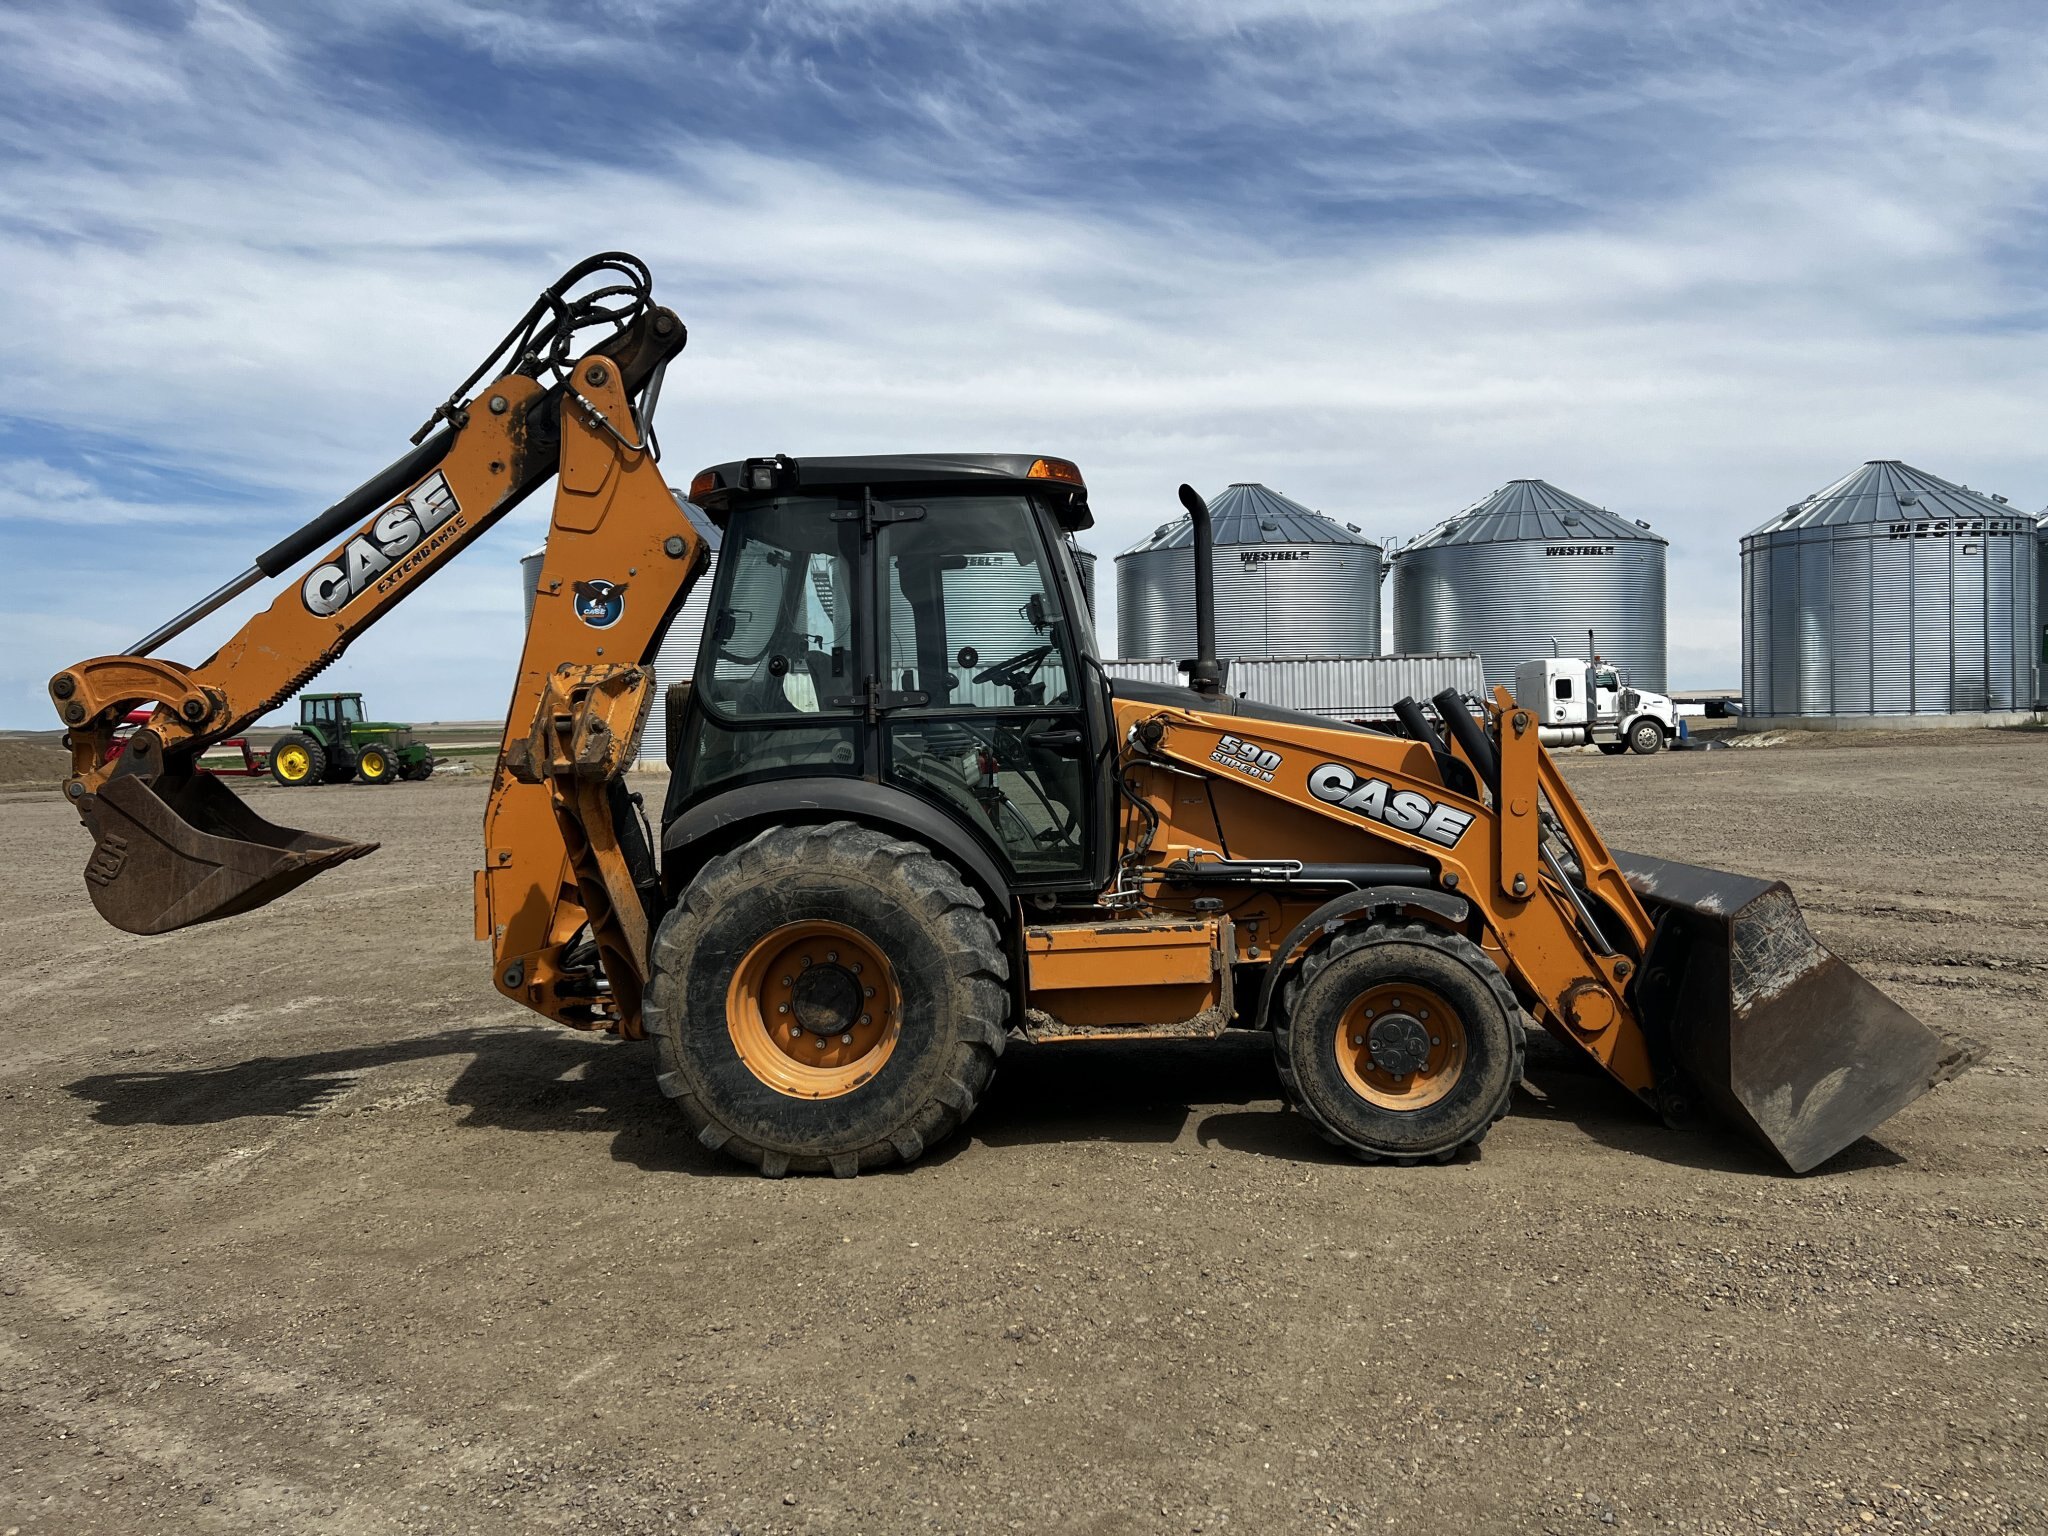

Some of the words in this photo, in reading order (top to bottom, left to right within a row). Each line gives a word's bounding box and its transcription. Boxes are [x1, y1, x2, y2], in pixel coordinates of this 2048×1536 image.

[303, 470, 460, 616] CASE
[1889, 522, 2010, 540] WESTEEL
[1241, 551, 1300, 561] WESTEEL
[1546, 546, 1602, 556] WESTEEL
[1209, 751, 1261, 778] SUPER
[1260, 770, 1275, 783] N
[1217, 734, 1283, 771] 590
[1308, 762, 1475, 848] CASE
